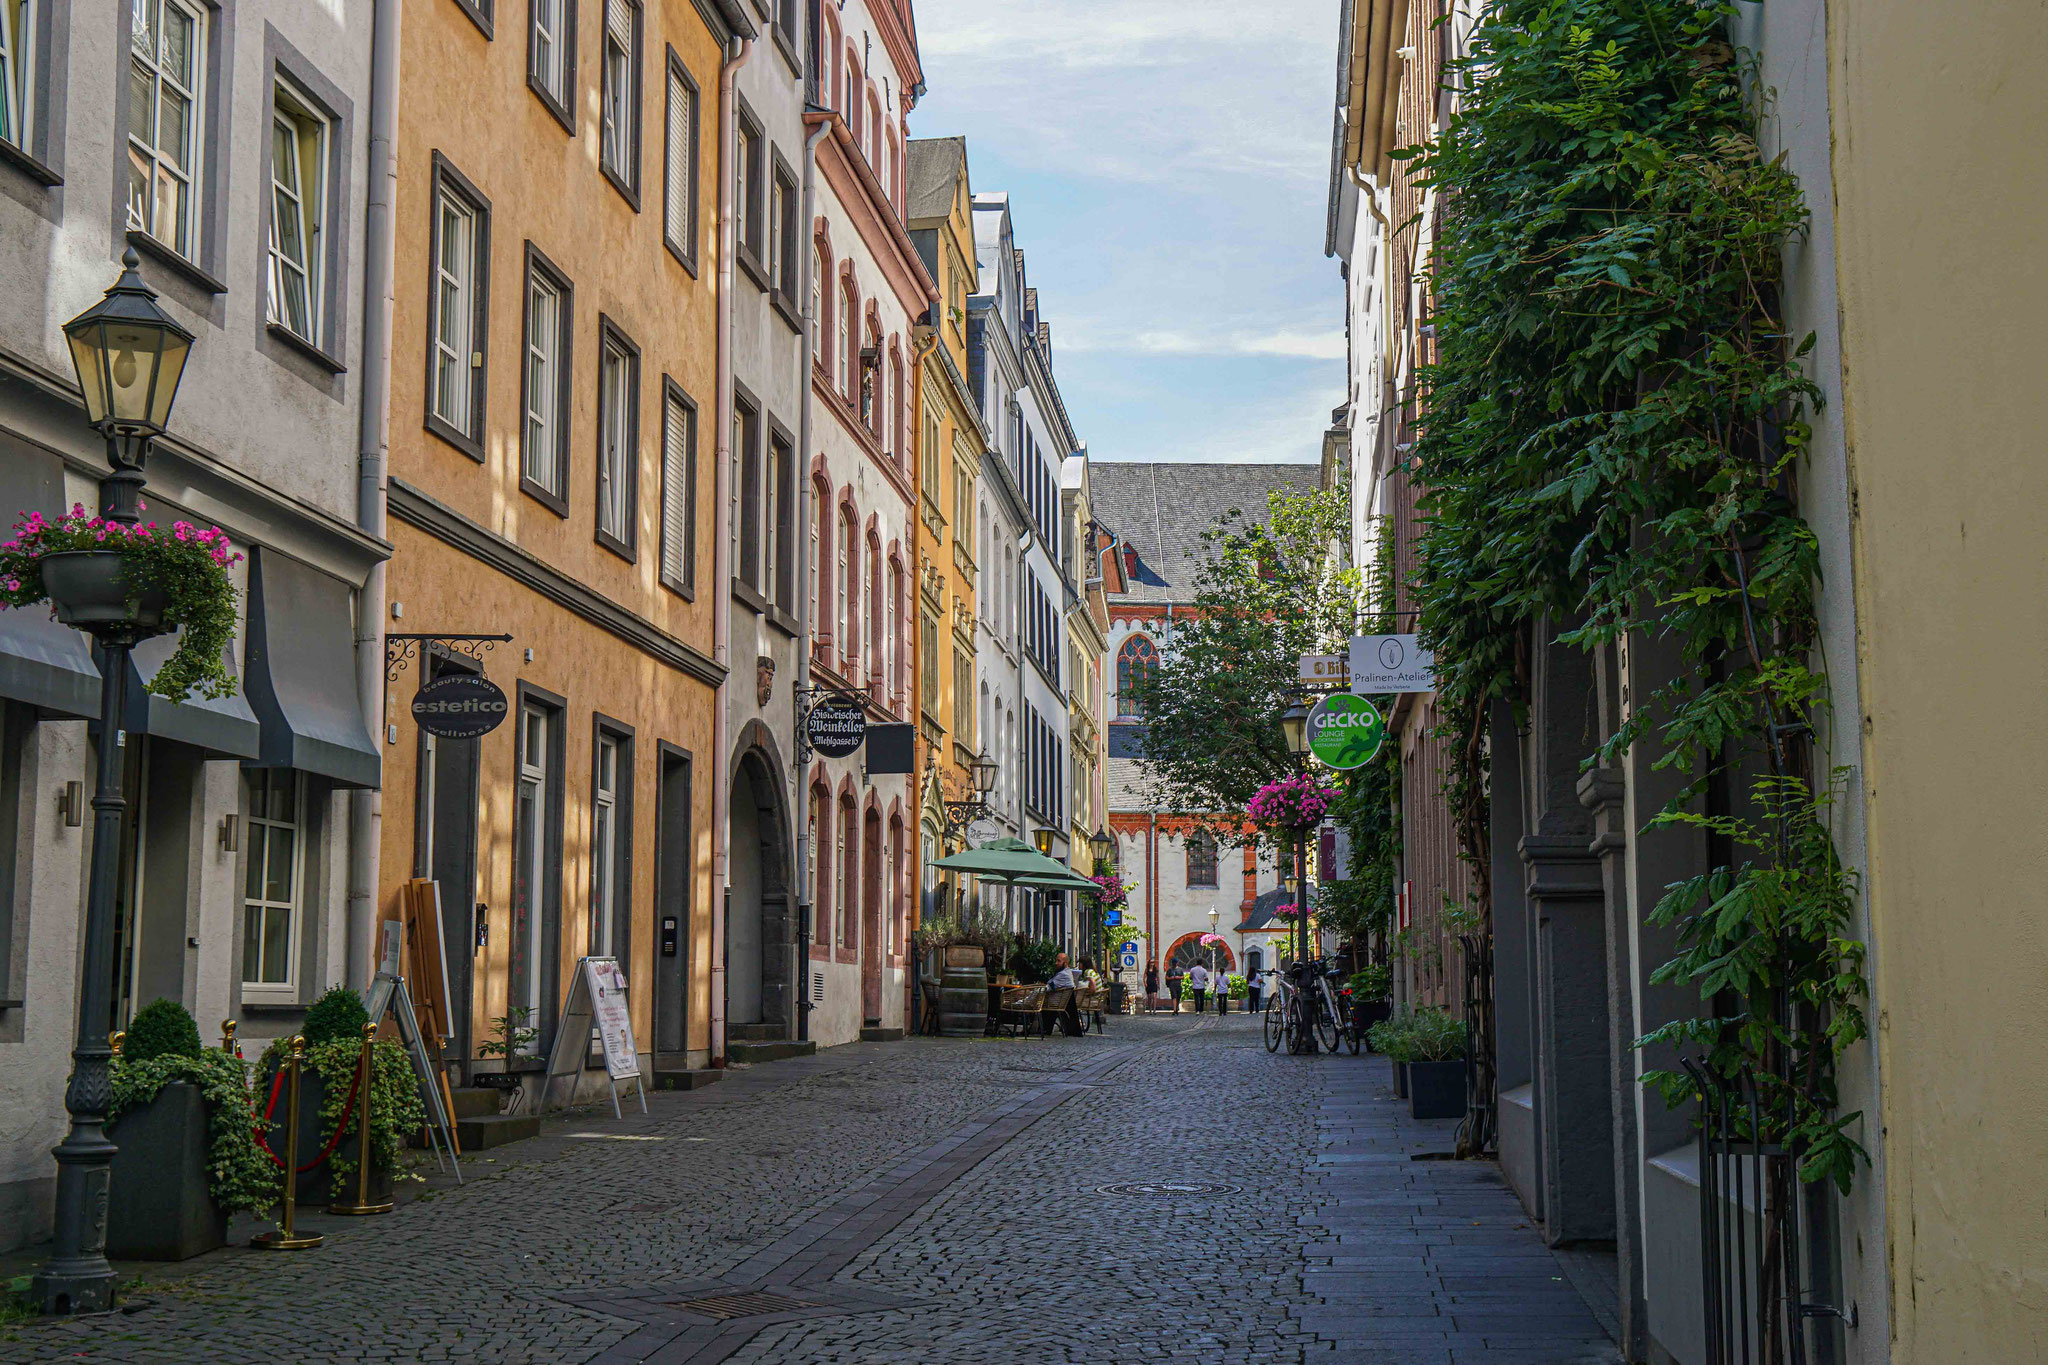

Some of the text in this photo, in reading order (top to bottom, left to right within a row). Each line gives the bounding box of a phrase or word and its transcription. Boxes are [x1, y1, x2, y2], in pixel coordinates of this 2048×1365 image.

[1354, 671, 1431, 683] Pralinen-Atelier
[423, 677, 496, 693] beauty salon
[412, 698, 506, 712] estetico
[811, 709, 861, 720] Historischer
[1314, 712, 1374, 728] GECKO
[427, 724, 491, 737] wellness
[809, 720, 864, 733] Weinkeller
[1314, 730, 1345, 738] LOUNGE
[814, 735, 851, 747] Mehlgasse
